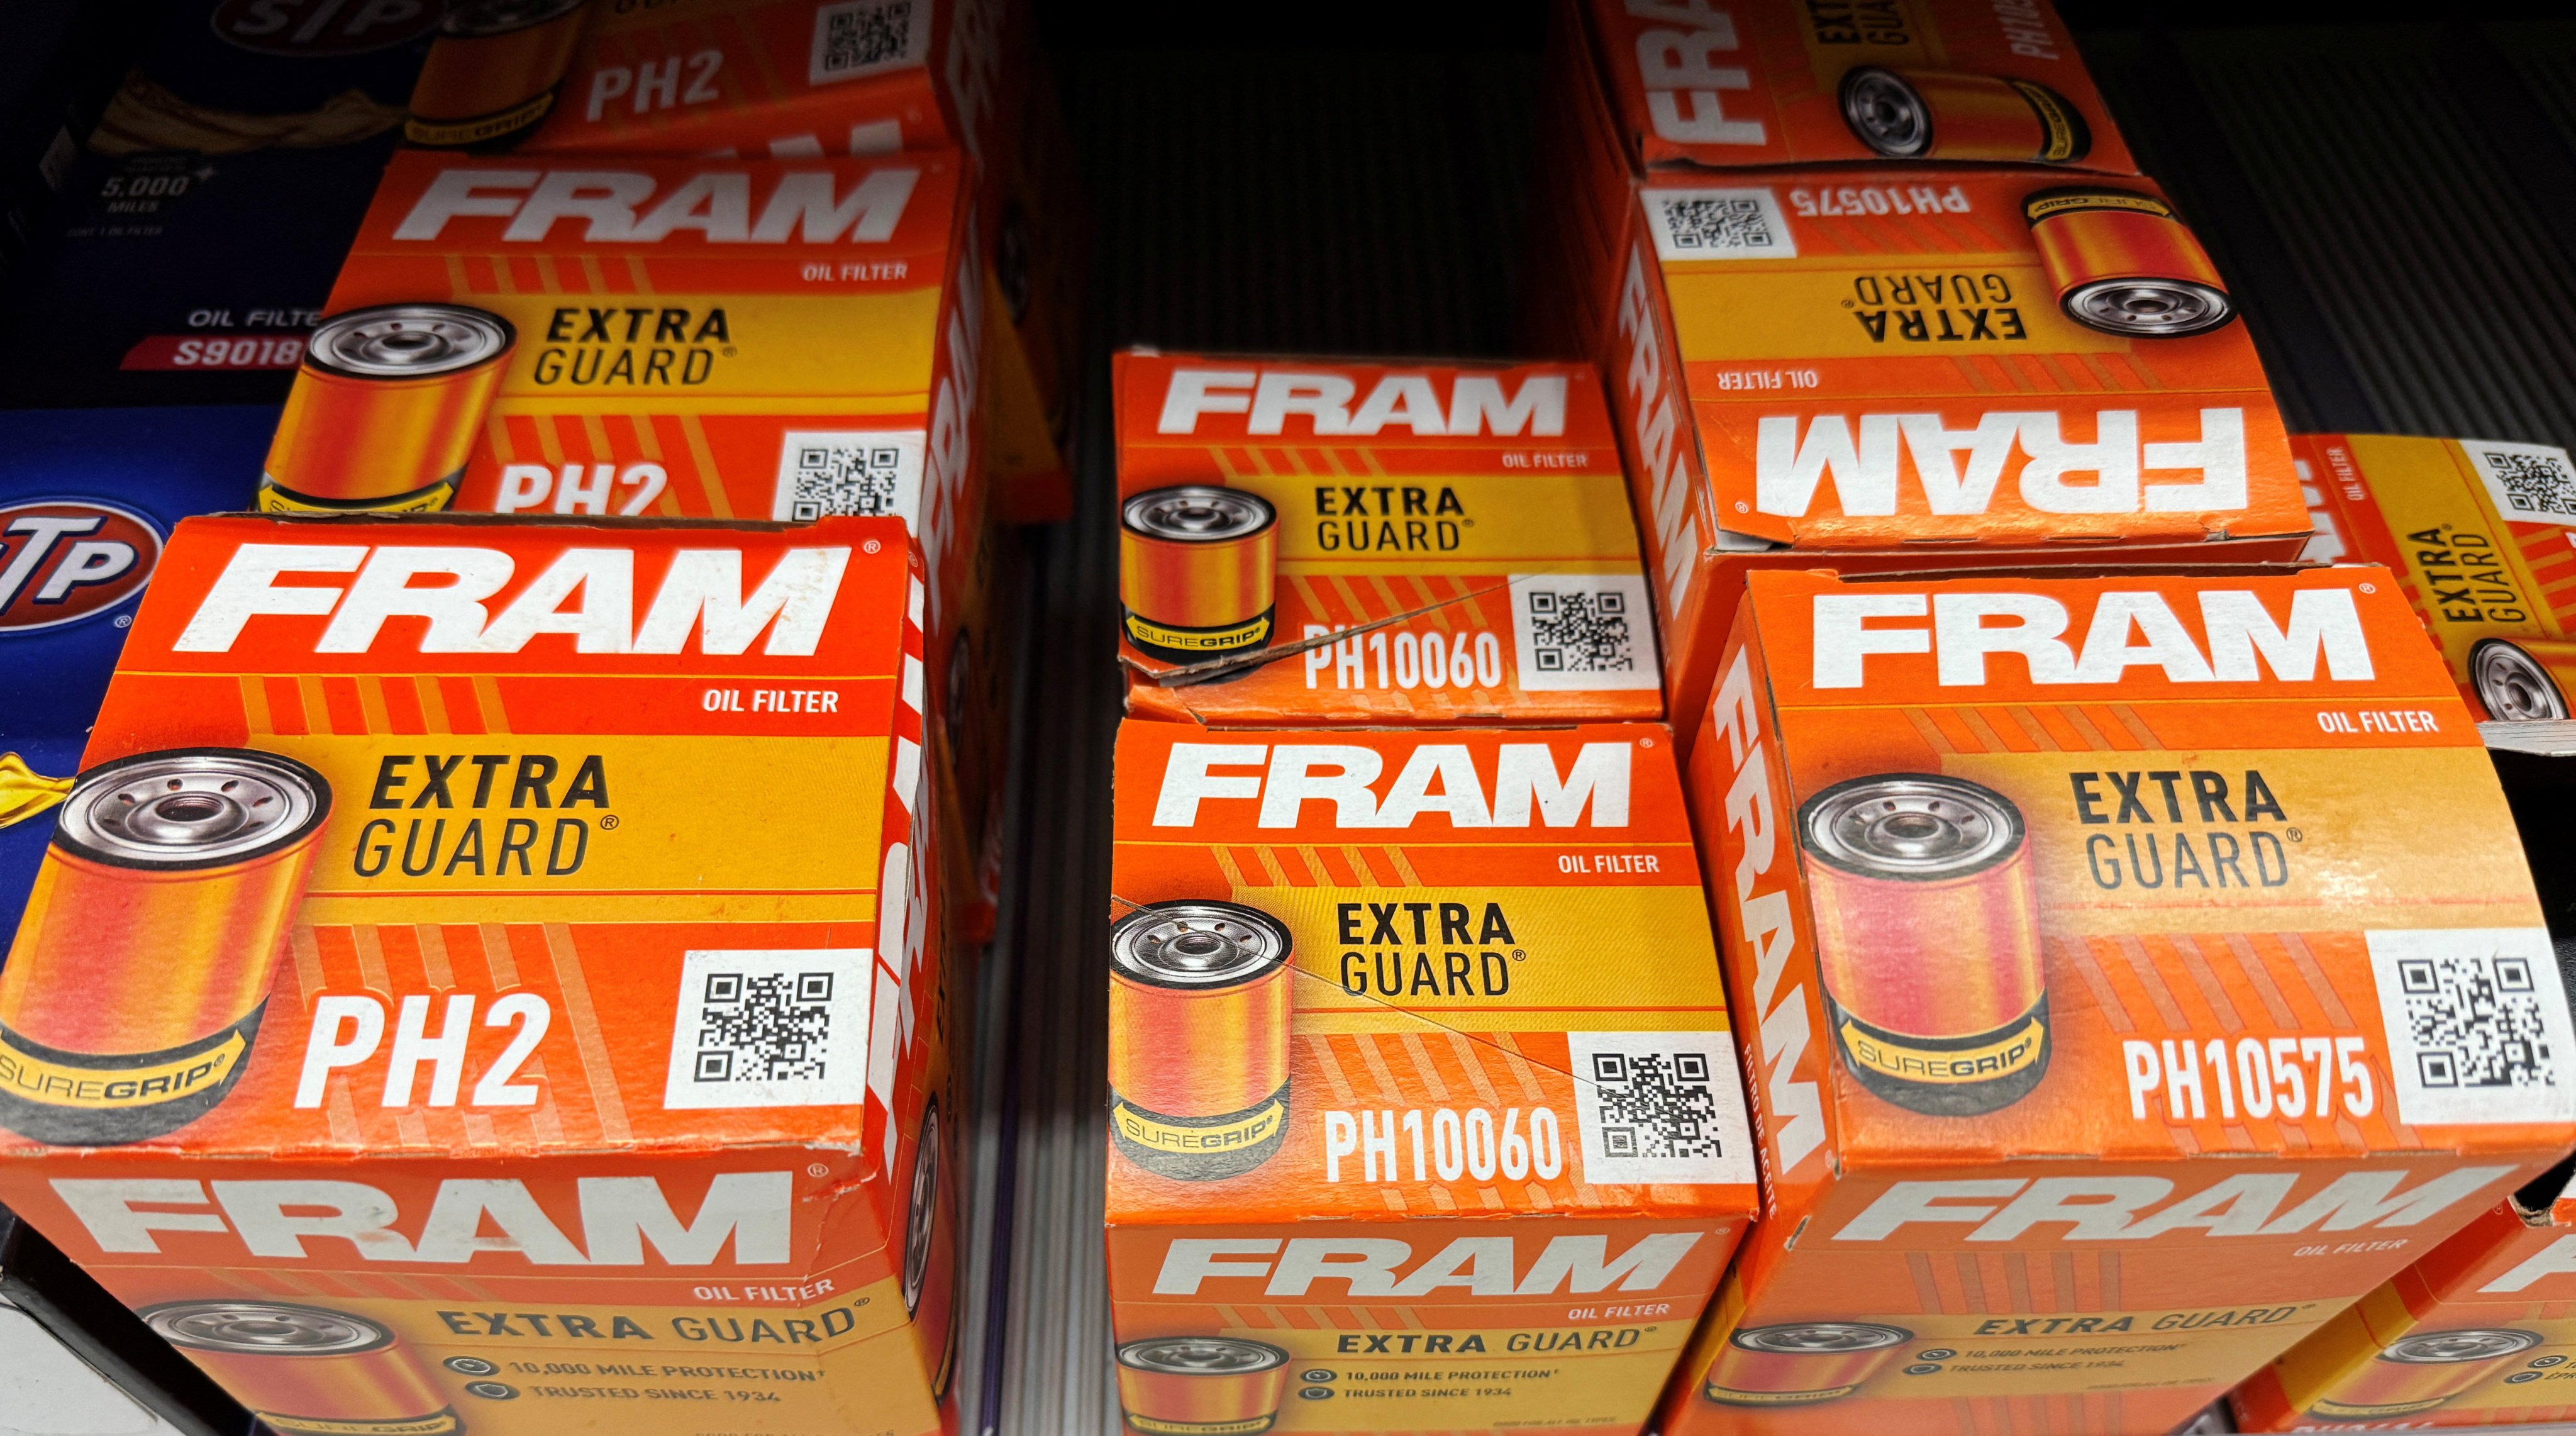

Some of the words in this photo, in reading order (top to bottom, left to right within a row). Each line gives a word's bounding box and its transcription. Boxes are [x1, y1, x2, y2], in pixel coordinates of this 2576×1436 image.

[1807, 0, 1861, 45] EXT
[1857, 0, 1909, 45] GUA
[1989, 0, 2060, 60] PH10
[586, 48, 724, 123] PH2
[1623, 0, 1767, 147] FRA
[392, 167, 922, 243] FRAM
[1790, 185, 1971, 217] PH10575
[801, 262, 835, 282] OIL
[840, 261, 908, 282] FILTER
[187, 308, 235, 328] OIL
[245, 308, 322, 328] FILTE
[547, 308, 731, 343] EXTRA
[1852, 308, 2027, 343] EXTRA
[172, 338, 304, 366] S9018
[1717, 370, 1782, 391] FILTER
[1785, 370, 1819, 389] OIL
[1157, 370, 1568, 437] FRAM
[1617, 236, 1698, 621] FRAM
[1502, 454, 1531, 469] OIL
[1533, 453, 1589, 468] FILTER
[1757, 408, 2247, 517] FRAM
[2326, 446, 2356, 482] FILTER
[494, 464, 669, 516] PH2
[1315, 487, 1465, 517] EXTRA
[2342, 483, 2367, 501] OIL
[0, 516, 136, 616] TP
[2406, 525, 2484, 623] EXTRA
[172, 543, 852, 657] FRAM
[1303, 624, 1501, 690] PH10060
[1813, 587, 2375, 689] FRAM
[702, 689, 745, 713] OIL
[753, 689, 840, 714] FILTER
[2316, 711, 2358, 733] OIL
[2358, 710, 2440, 733] FILTER
[369, 755, 610, 810] EXTRA
[1152, 740, 1633, 829] FRAM
[2069, 769, 2288, 825] EXTRA
[1558, 855, 1587, 874] OIL
[1595, 855, 1660, 873] FILTER
[1337, 902, 1516, 945] EXTRA
[1713, 643, 1826, 1176] FRAM
[294, 993, 551, 1108] PH2
[2123, 1037, 2373, 1120] PH10575
[1324, 1107, 1562, 1183] PH10060
[1744, 1042, 1760, 1113] FILTRO
[1755, 1112, 1765, 1145] DE
[1760, 1147, 1777, 1220] ACEITE
[48, 1171, 793, 1266] FRAM
[1831, 1165, 2521, 1241] FRAM
[1152, 1232, 1706, 1296] FRAM
[2293, 1245, 2328, 1257] OIL
[2332, 1238, 2409, 1254] FILTER
[694, 1285, 740, 1301] OIL
[745, 1278, 836, 1302] FILTER
[437, 1310, 655, 1341] EXTRA
[1567, 1308, 1597, 1320] OIL
[1604, 1303, 1670, 1318] FILTER
[1972, 1315, 2135, 1336] EXTRA
[1336, 1333, 1486, 1354] EXTRA
[1965, 1349, 2022, 1359] 10,000
[2023, 1348, 2069, 1357] MILE
[509, 1361, 592, 1376] 10,000
[596, 1363, 658, 1377] MILE
[1346, 1371, 1399, 1382] 10,000
[1403, 1371, 1443, 1381] MILE
[1950, 1363, 2027, 1372] TRUSTED
[2028, 1361, 2082, 1371] SINCE
[529, 1386, 641, 1400] TRUSTED
[643, 1388, 719, 1400] SINCE
[723, 1389, 782, 1402] 1934
[1343, 1388, 1416, 1398] TRUSTED
[1421, 1388, 1470, 1398] SINCE
[1475, 1387, 1512, 1396] 1934
